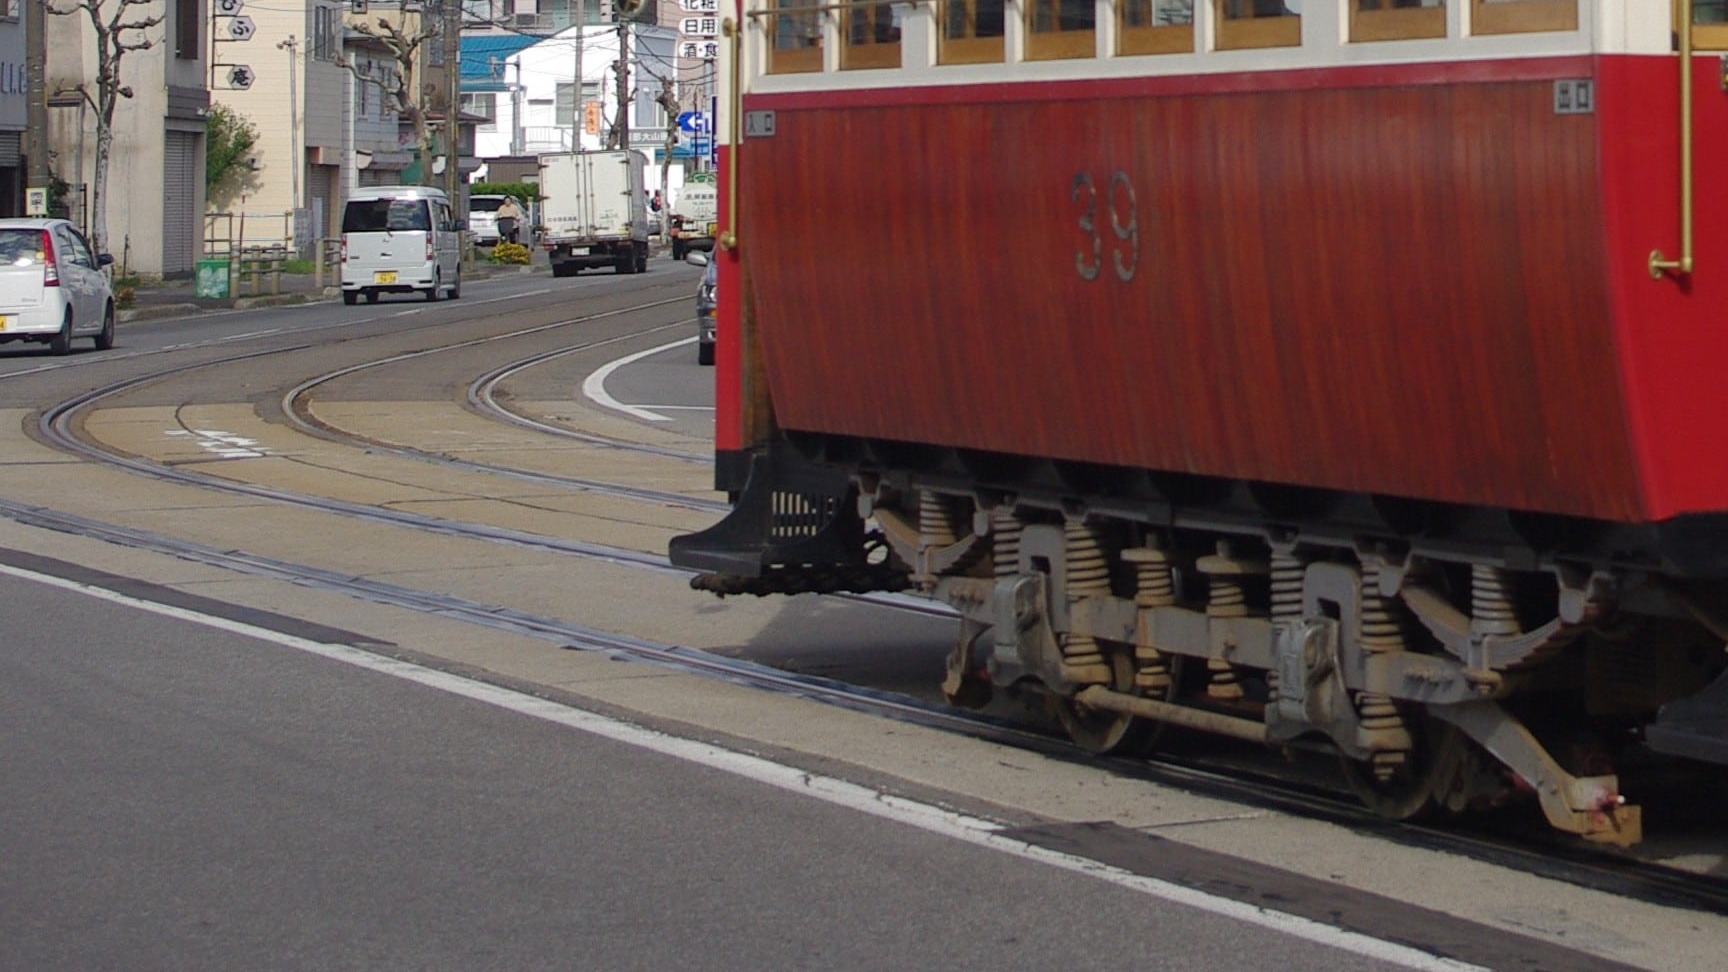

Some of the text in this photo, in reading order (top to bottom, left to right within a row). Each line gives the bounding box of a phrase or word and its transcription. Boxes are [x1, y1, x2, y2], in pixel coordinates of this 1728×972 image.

[1558, 82, 1589, 109] 出口
[747, 113, 773, 133] 入口
[1070, 169, 1139, 282] 39
